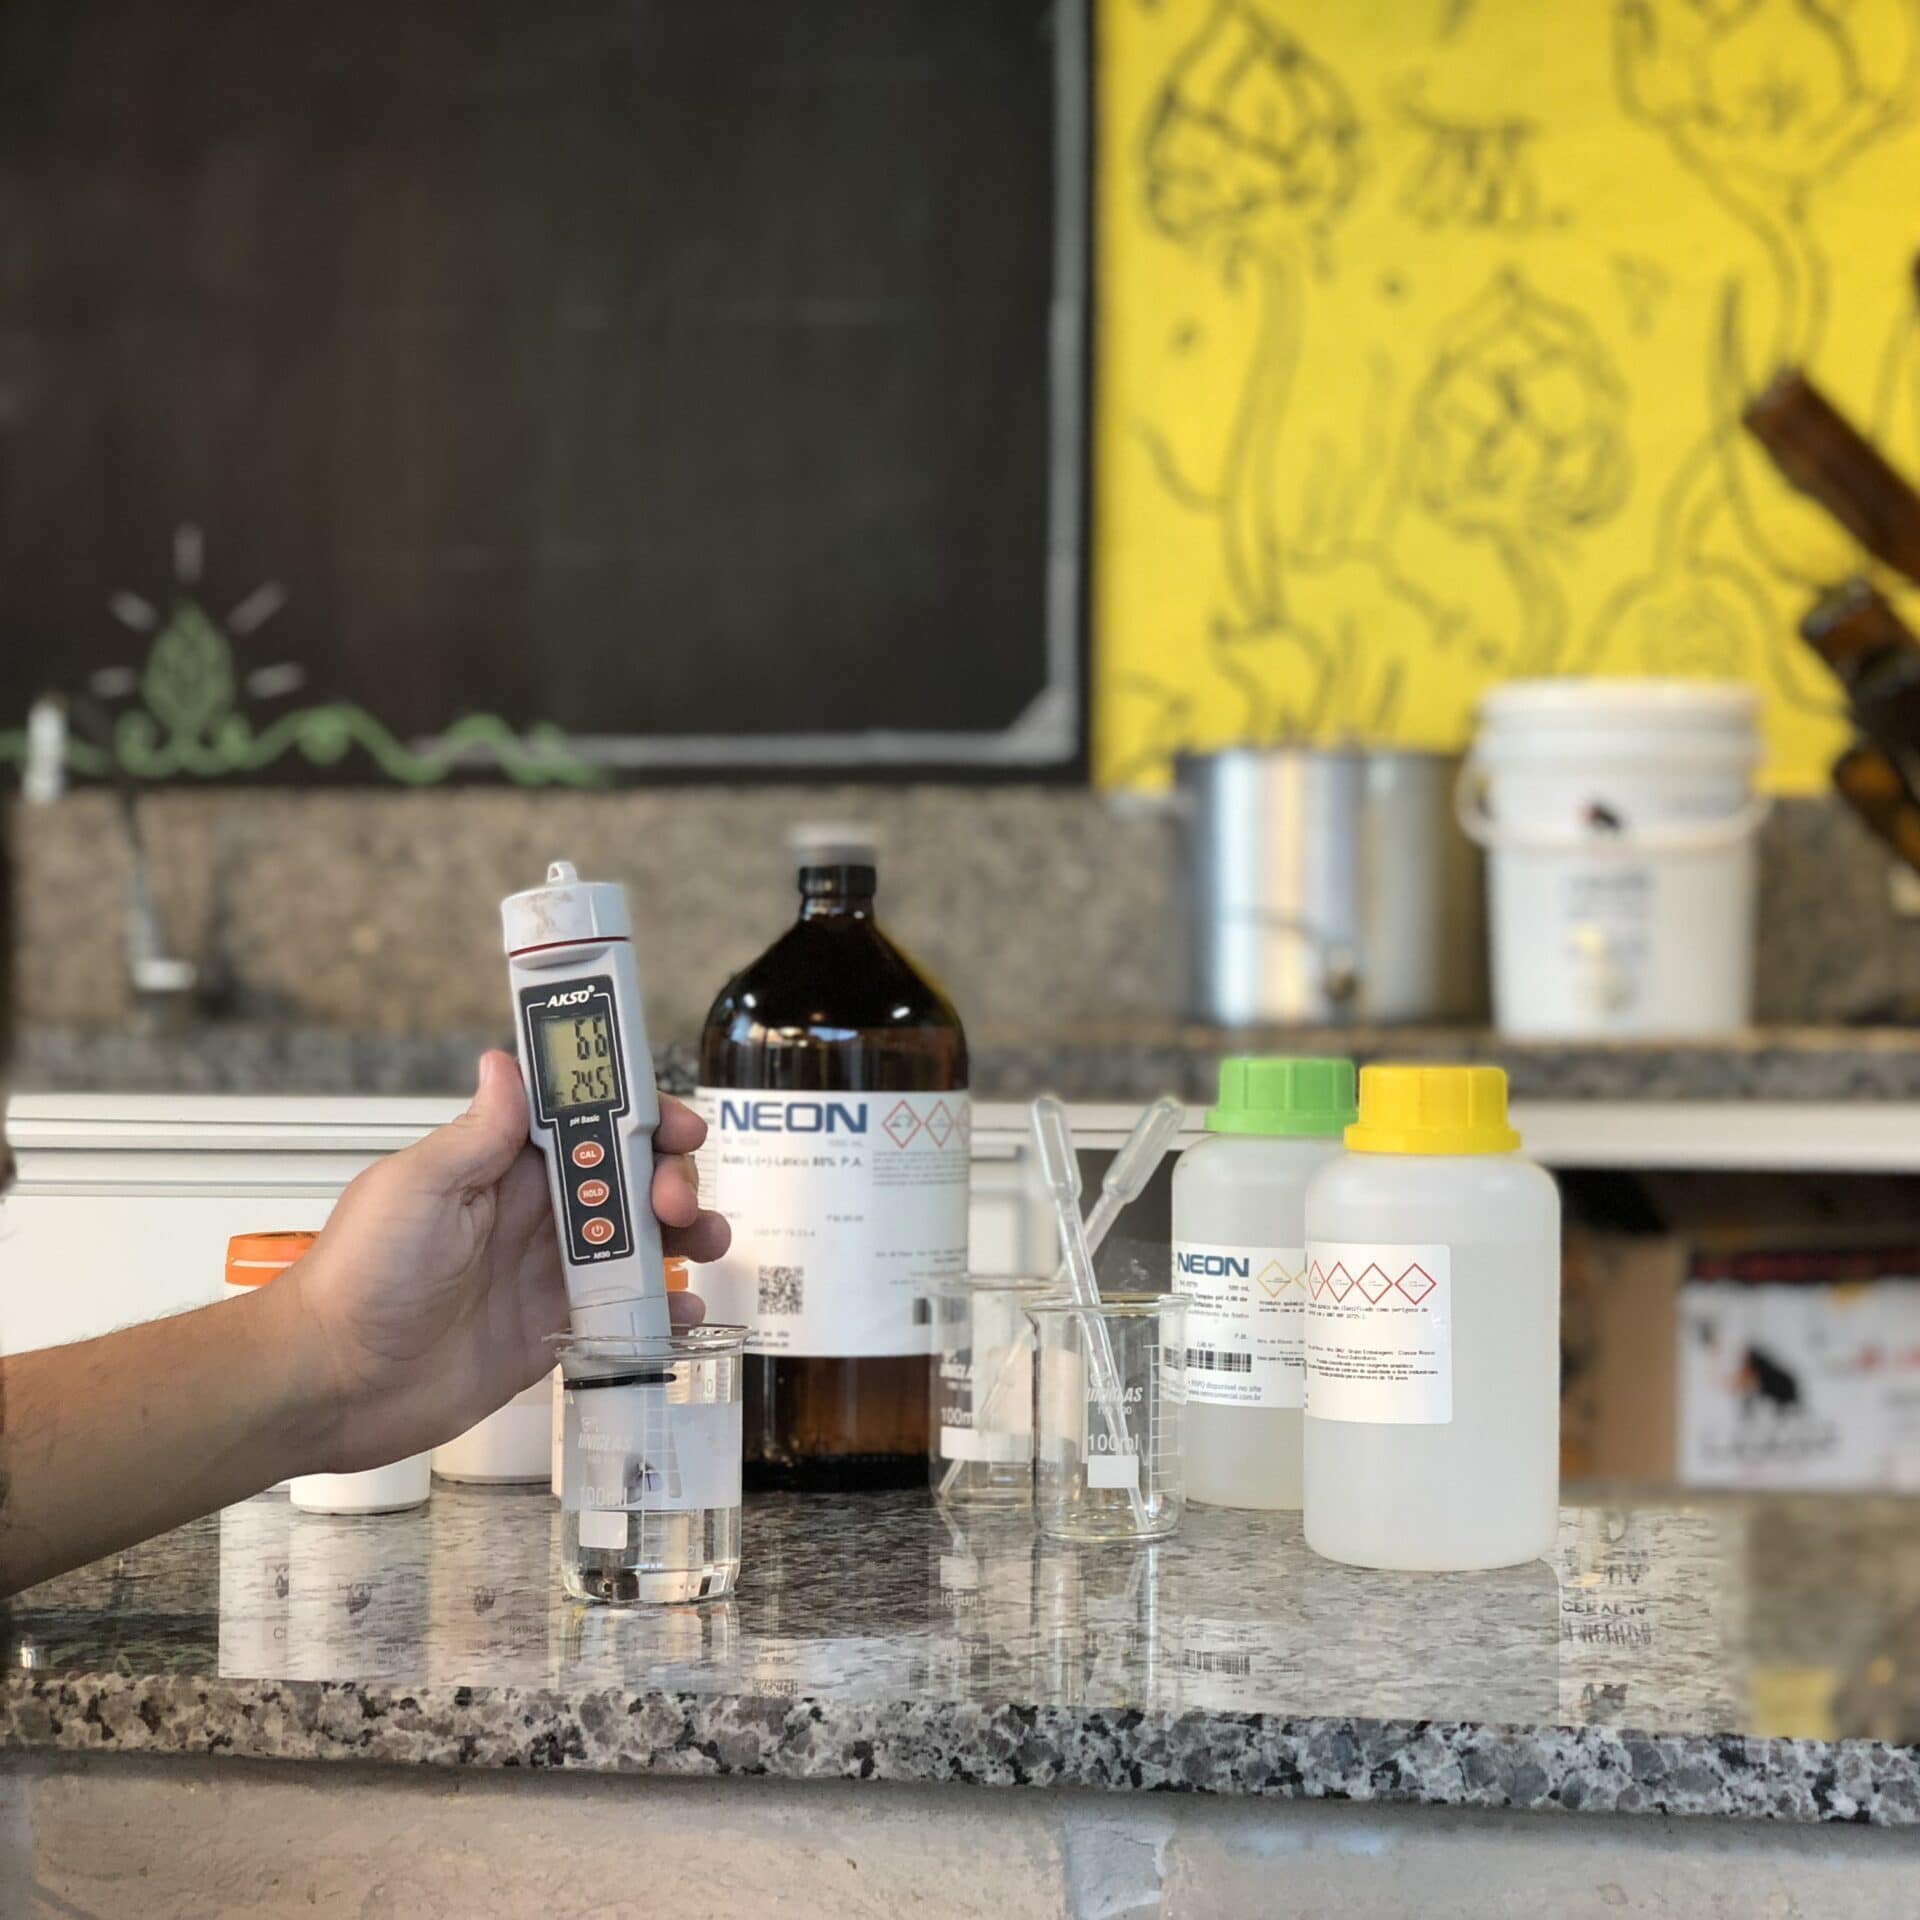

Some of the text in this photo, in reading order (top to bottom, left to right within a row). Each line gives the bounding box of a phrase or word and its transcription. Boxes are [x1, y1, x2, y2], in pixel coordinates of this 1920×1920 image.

[547, 990, 590, 1009] AKSO
[570, 1114, 600, 1127] pH Basic
[721, 1101, 867, 1133] NEON
[579, 1150, 597, 1160] CAL
[583, 1190, 604, 1199] HOLD
[1177, 1251, 1250, 1278] NEON
